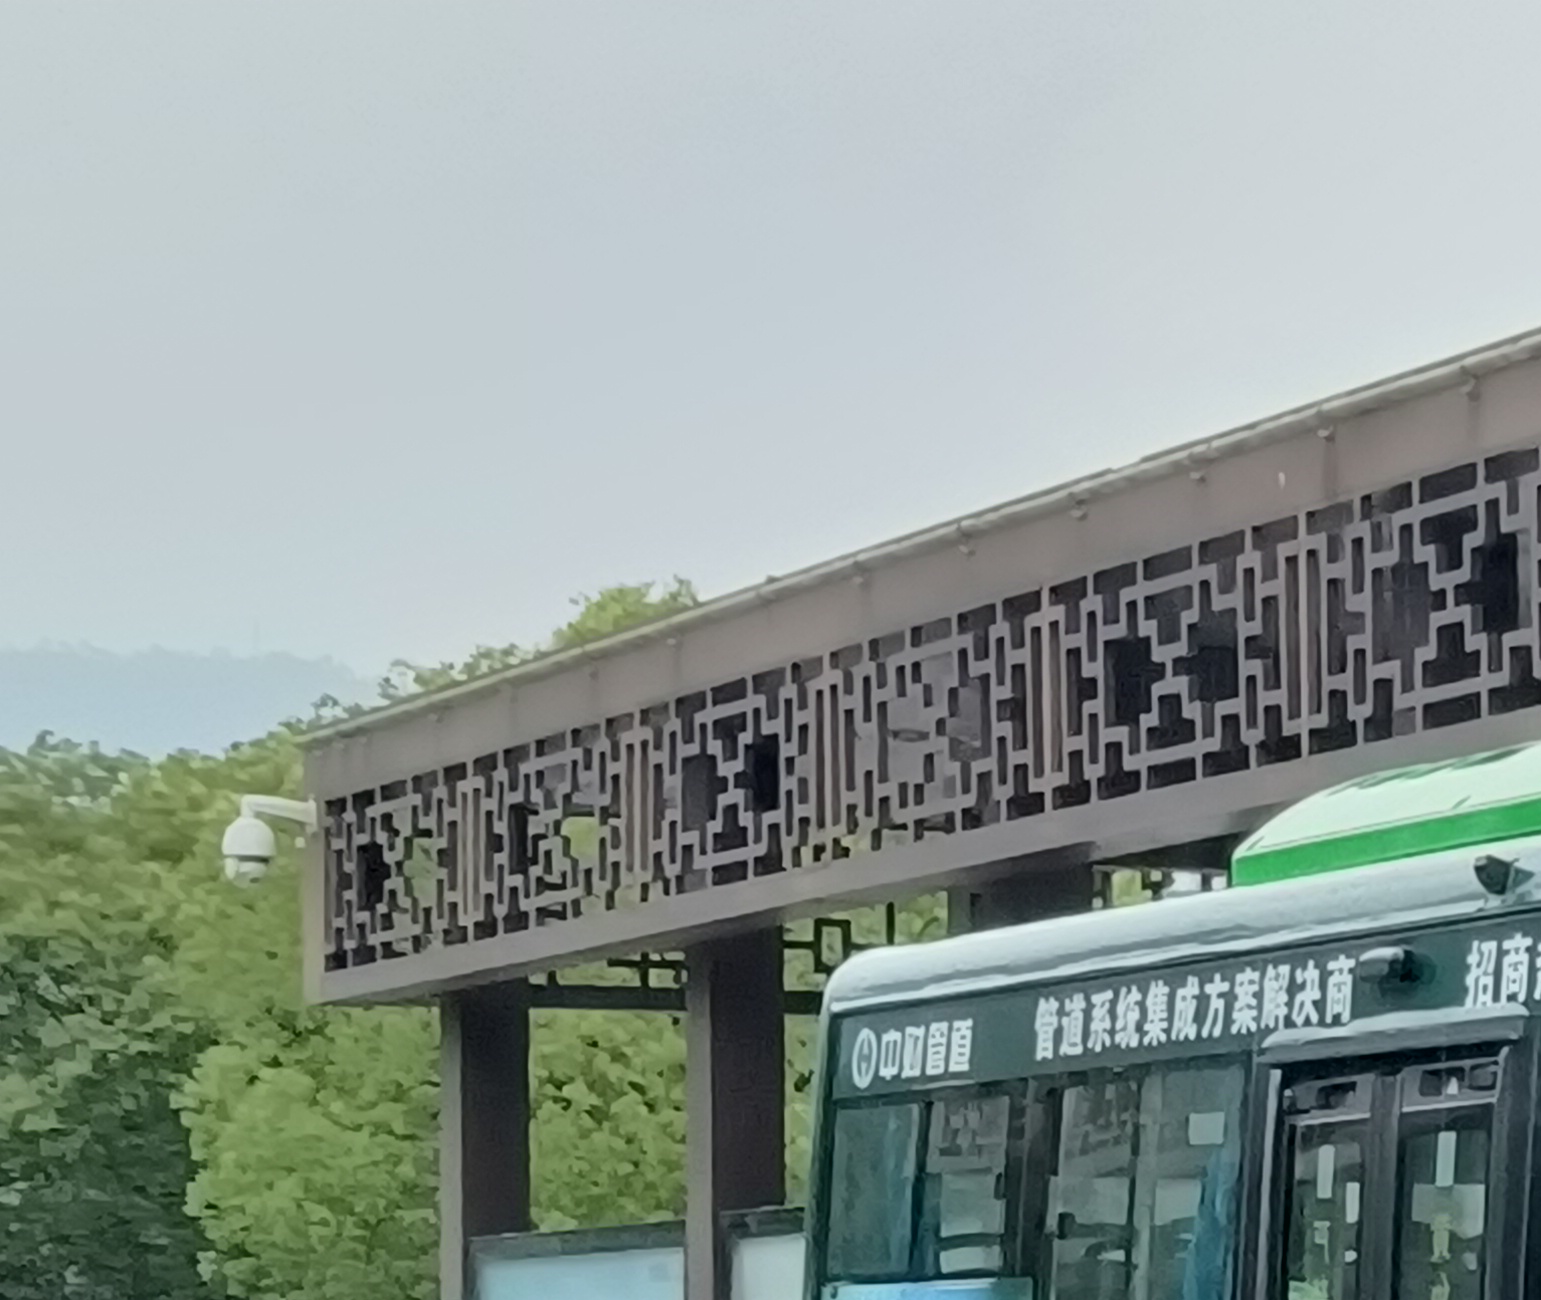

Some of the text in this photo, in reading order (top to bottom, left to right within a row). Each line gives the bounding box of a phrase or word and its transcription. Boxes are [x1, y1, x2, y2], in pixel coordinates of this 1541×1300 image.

[1034, 953, 1357, 1062] 管道系统集成方案解决商
